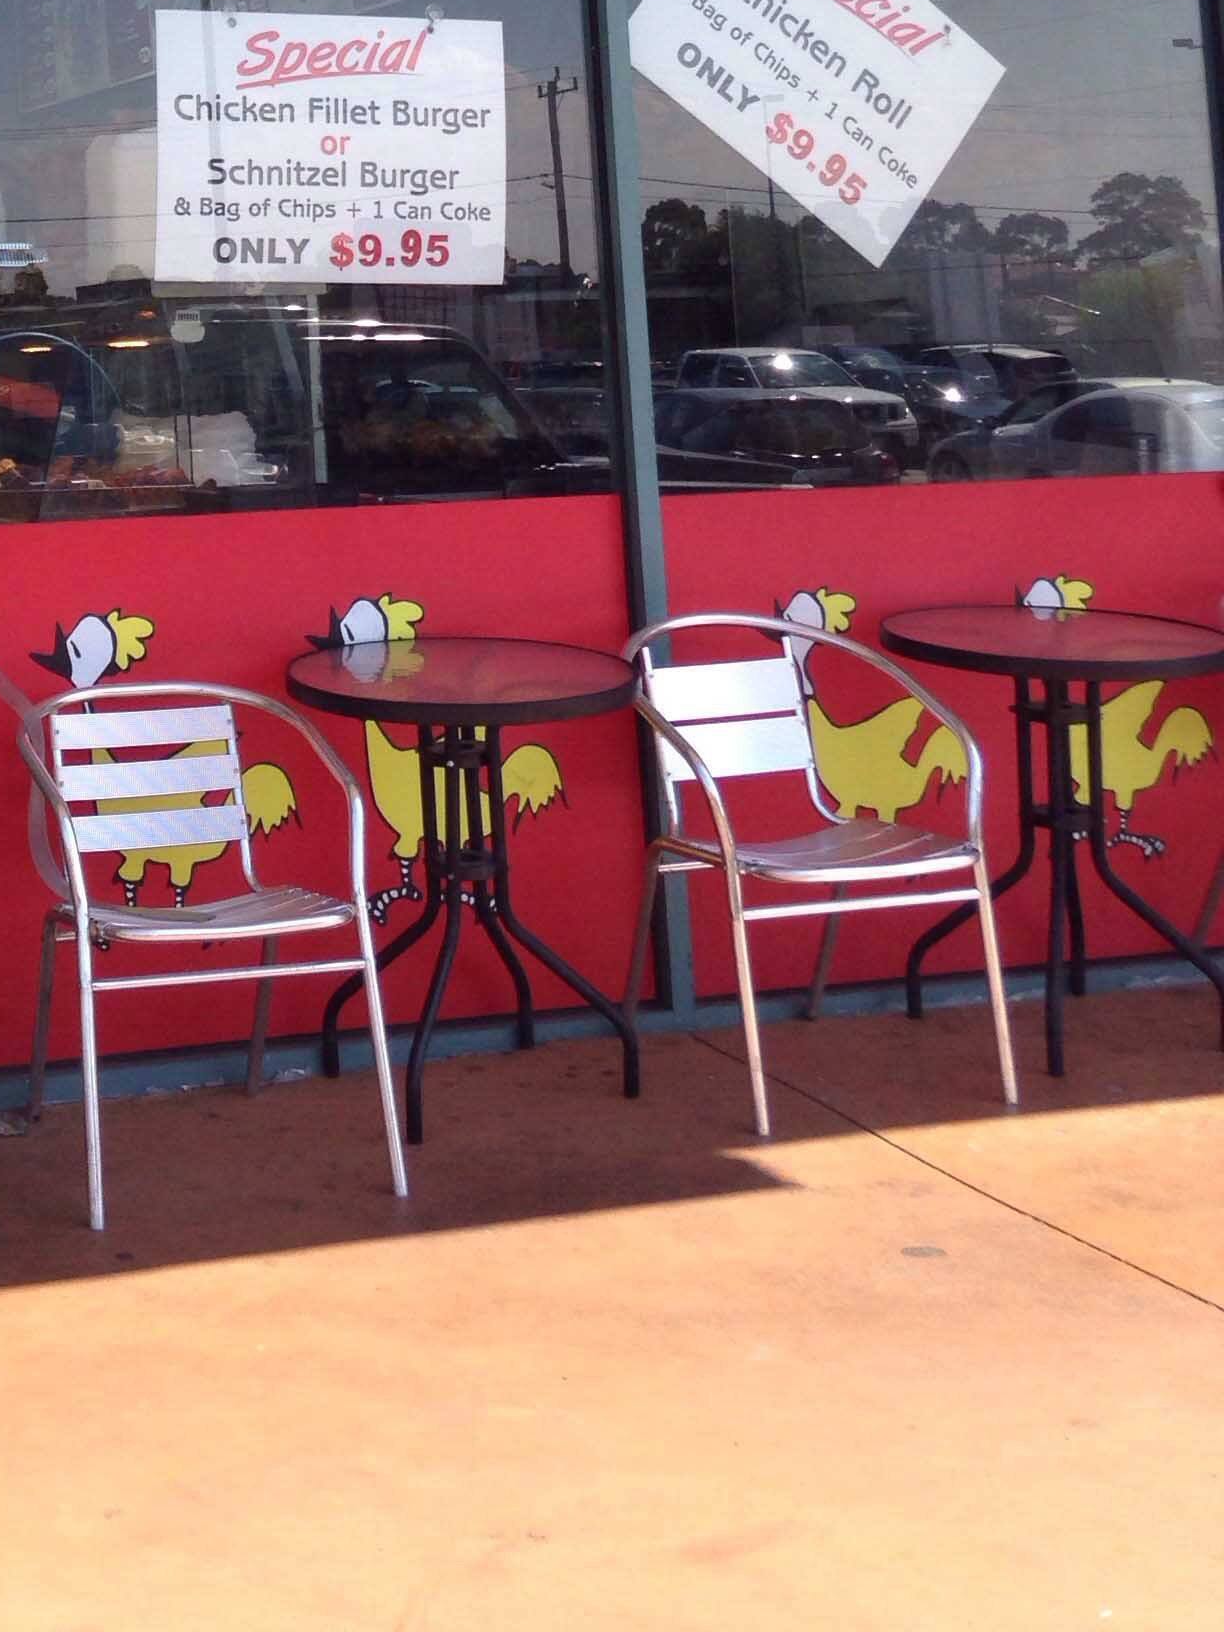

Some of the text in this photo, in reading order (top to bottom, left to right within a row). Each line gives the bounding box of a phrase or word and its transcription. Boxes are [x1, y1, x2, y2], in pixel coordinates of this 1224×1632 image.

[236, 29, 429, 89] Special
[173, 94, 491, 135] Chicken Fillet Burger
[730, 25, 753, 47] of
[753, 41, 801, 90] Chips
[824, 101, 840, 120] 1
[841, 115, 875, 152] Can
[878, 146, 919, 189] Coke
[850, 67, 913, 130] Roll
[676, 42, 869, 205] ONLY $9.95
[319, 135, 351, 156] or
[207, 158, 459, 196] Schnitzel Burger
[174, 196, 192, 217] &
[199, 197, 241, 222] Bag
[248, 198, 271, 218] of
[278, 198, 337, 224] Chips
[373, 200, 383, 220] 1
[393, 200, 432, 221] Can
[440, 202, 491, 222] Coke
[212, 229, 450, 271] ONLY $9.95
